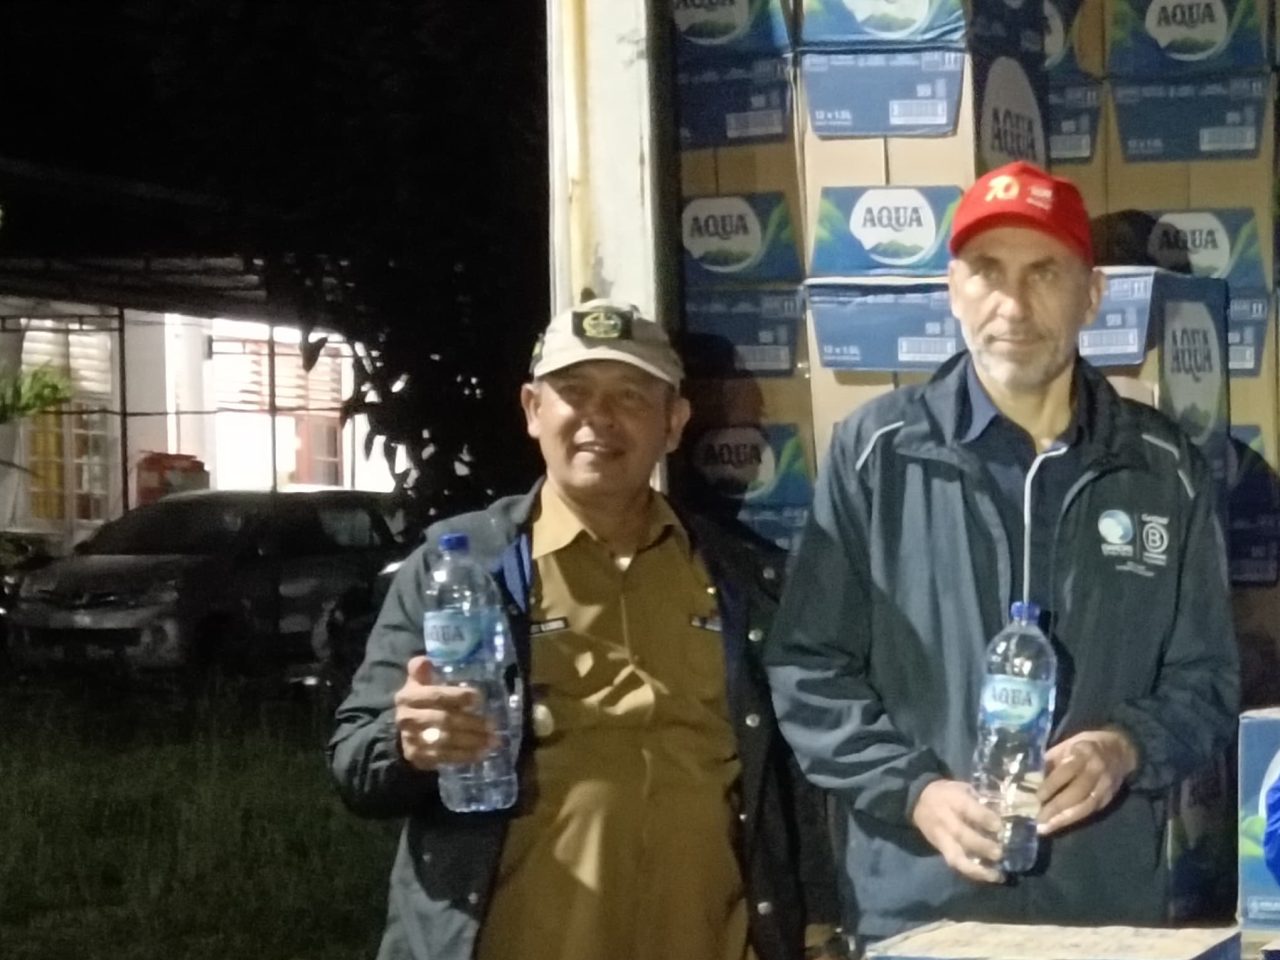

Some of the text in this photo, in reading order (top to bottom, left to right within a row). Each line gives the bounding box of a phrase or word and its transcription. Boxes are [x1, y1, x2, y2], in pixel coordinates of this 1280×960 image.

[1157, 5, 1216, 27] AQUA
[690, 214, 749, 240] AQUA
[862, 206, 923, 232] AQUA
[1158, 228, 1218, 252] AQUA
[1171, 327, 1213, 382] AQUA
